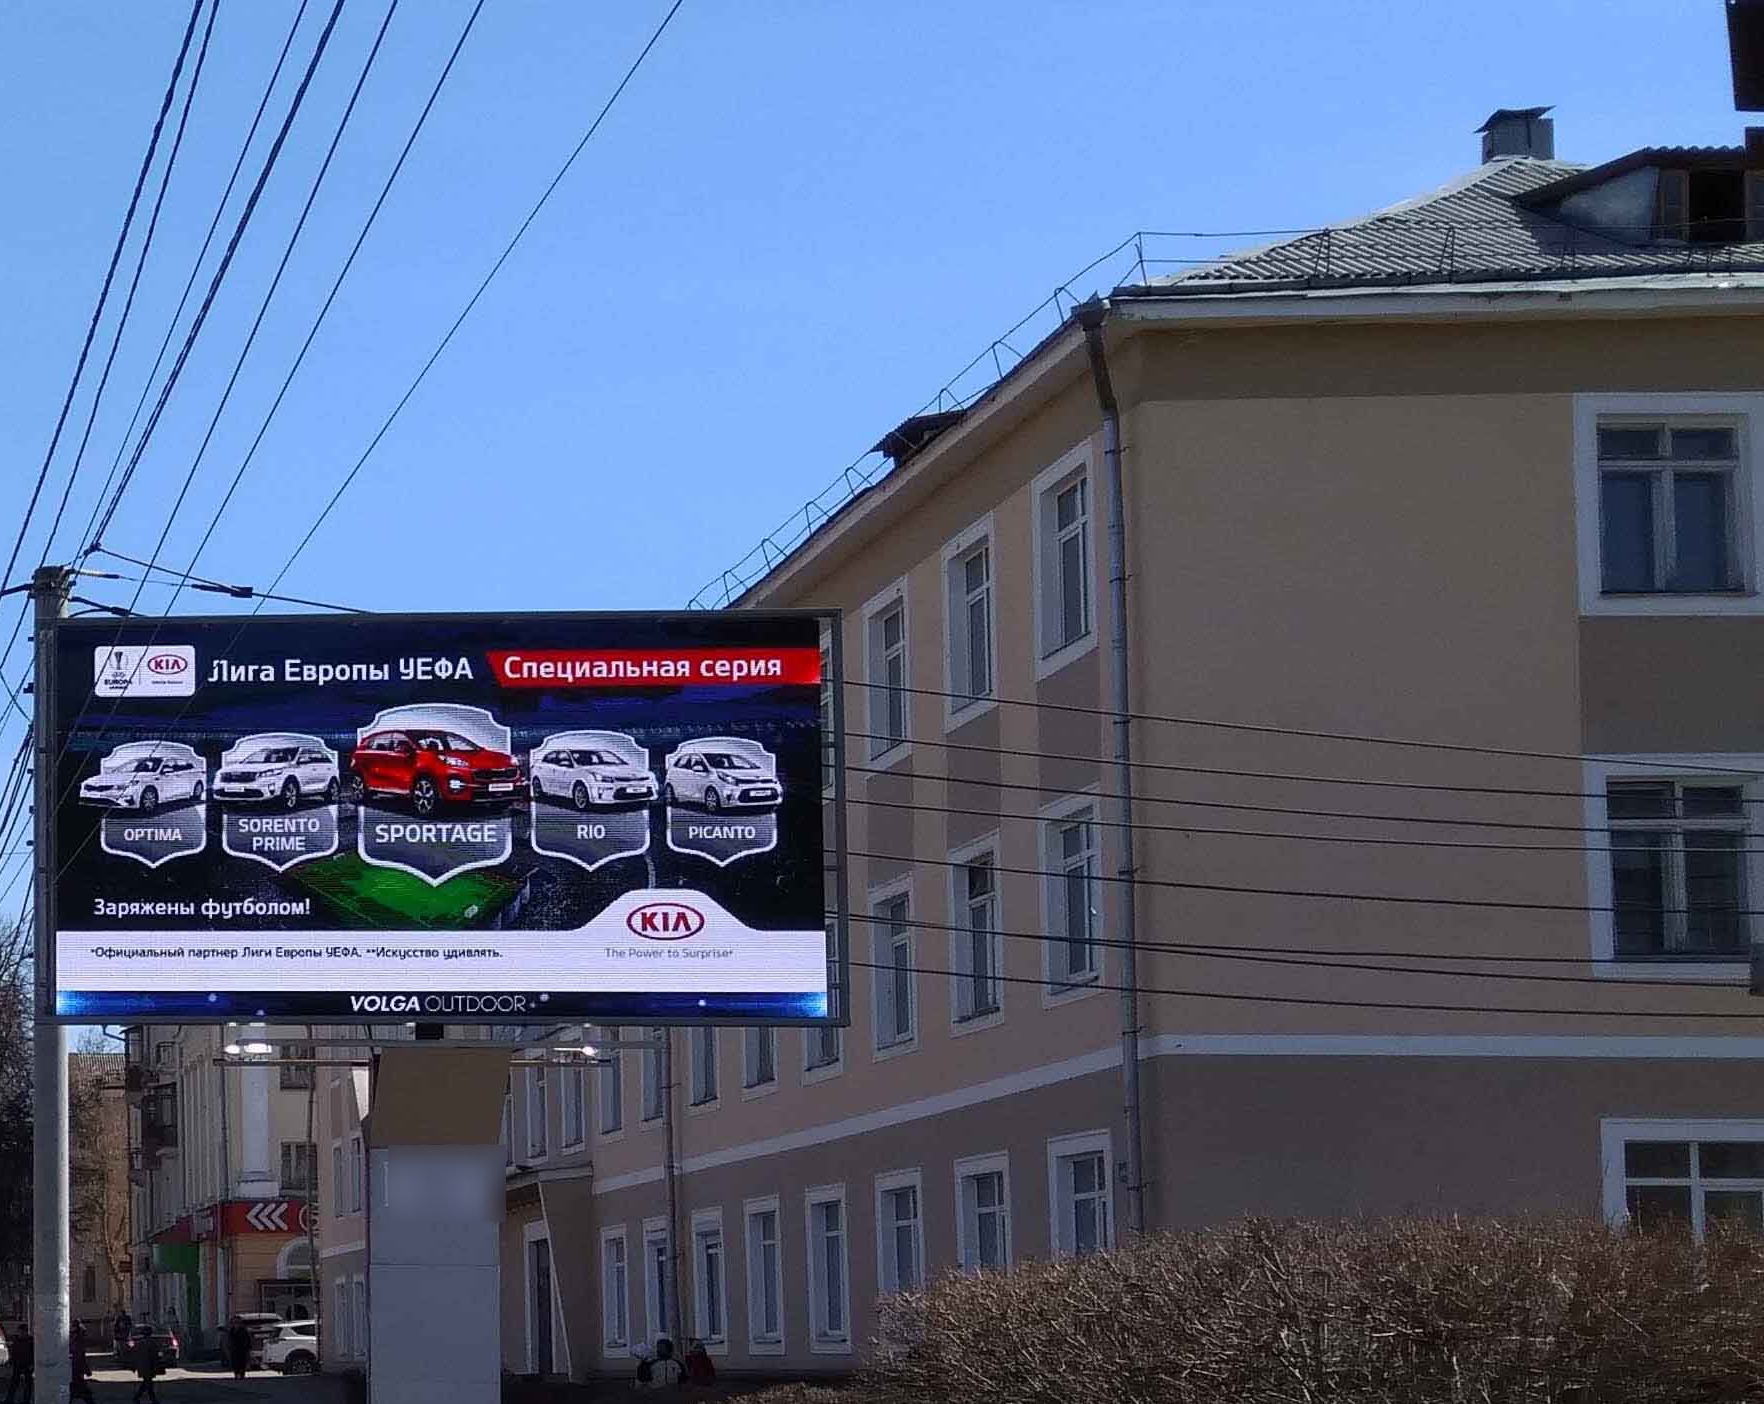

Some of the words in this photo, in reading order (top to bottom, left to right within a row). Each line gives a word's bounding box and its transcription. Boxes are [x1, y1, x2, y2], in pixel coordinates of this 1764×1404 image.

[208, 659, 275, 682] Лига
[284, 658, 389, 686] Европы
[399, 657, 474, 680] УЕФА
[504, 656, 691, 682] Специальная
[700, 658, 782, 681] серия
[238, 818, 320, 834] SORENTO
[375, 824, 497, 843] SPORTAGE
[576, 825, 606, 839] RIO
[688, 826, 756, 839] PICANTO
[124, 828, 182, 842] OPTIMA
[252, 836, 306, 851] PRIME
[93, 899, 195, 918] Заряжены
[201, 898, 311, 919] футболом!
[188, 949, 237, 959] партнер
[242, 947, 272, 958] Лиги
[276, 947, 322, 959] Европы
[443, 948, 503, 959] удивлять.
[605, 948, 626, 958] The
[629, 948, 663, 958] Power
[668, 949, 680, 958] to
[350, 995, 420, 1012] VOLGA
[424, 995, 526, 1012] OUTDOOR
